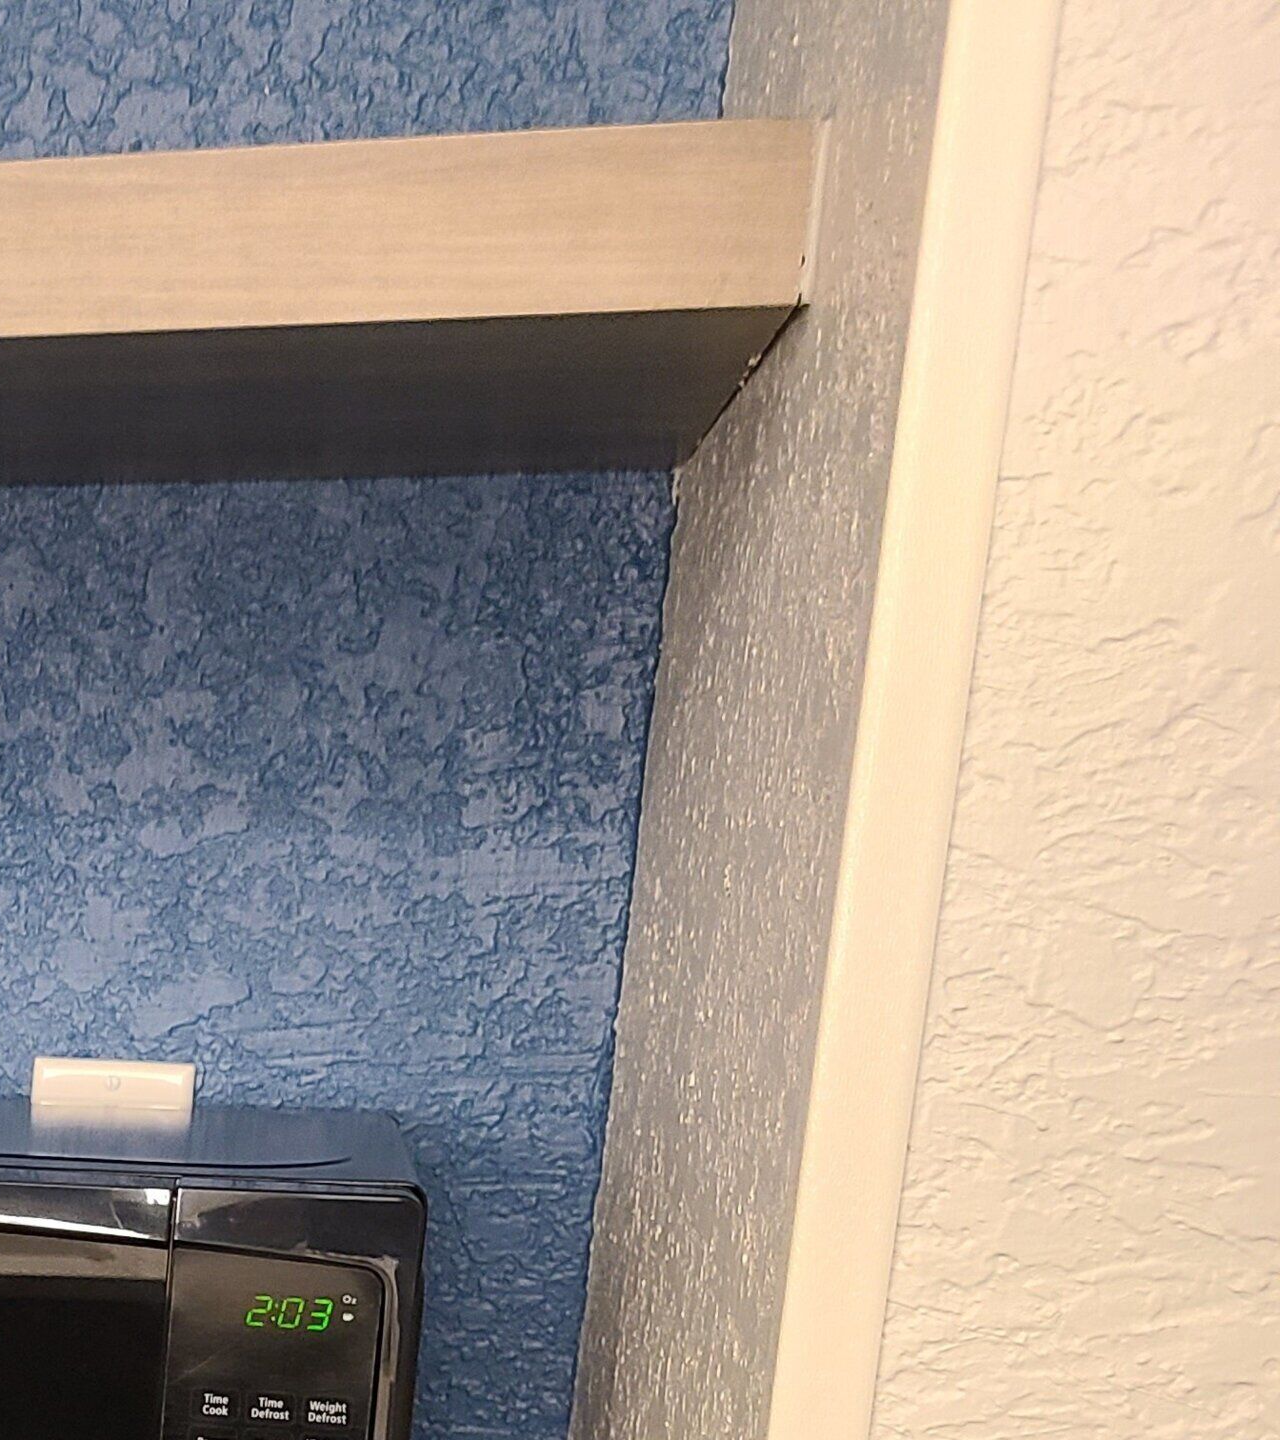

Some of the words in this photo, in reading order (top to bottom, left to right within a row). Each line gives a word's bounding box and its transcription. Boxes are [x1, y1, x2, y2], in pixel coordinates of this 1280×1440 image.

[244, 1294, 335, 1332] 2:03
[204, 1392, 230, 1405] Time
[258, 1396, 284, 1409] Time
[202, 1404, 229, 1417] Cook
[309, 1400, 347, 1415] Weight
[250, 1407, 290, 1422] Defrost
[307, 1412, 347, 1425] Defrost
